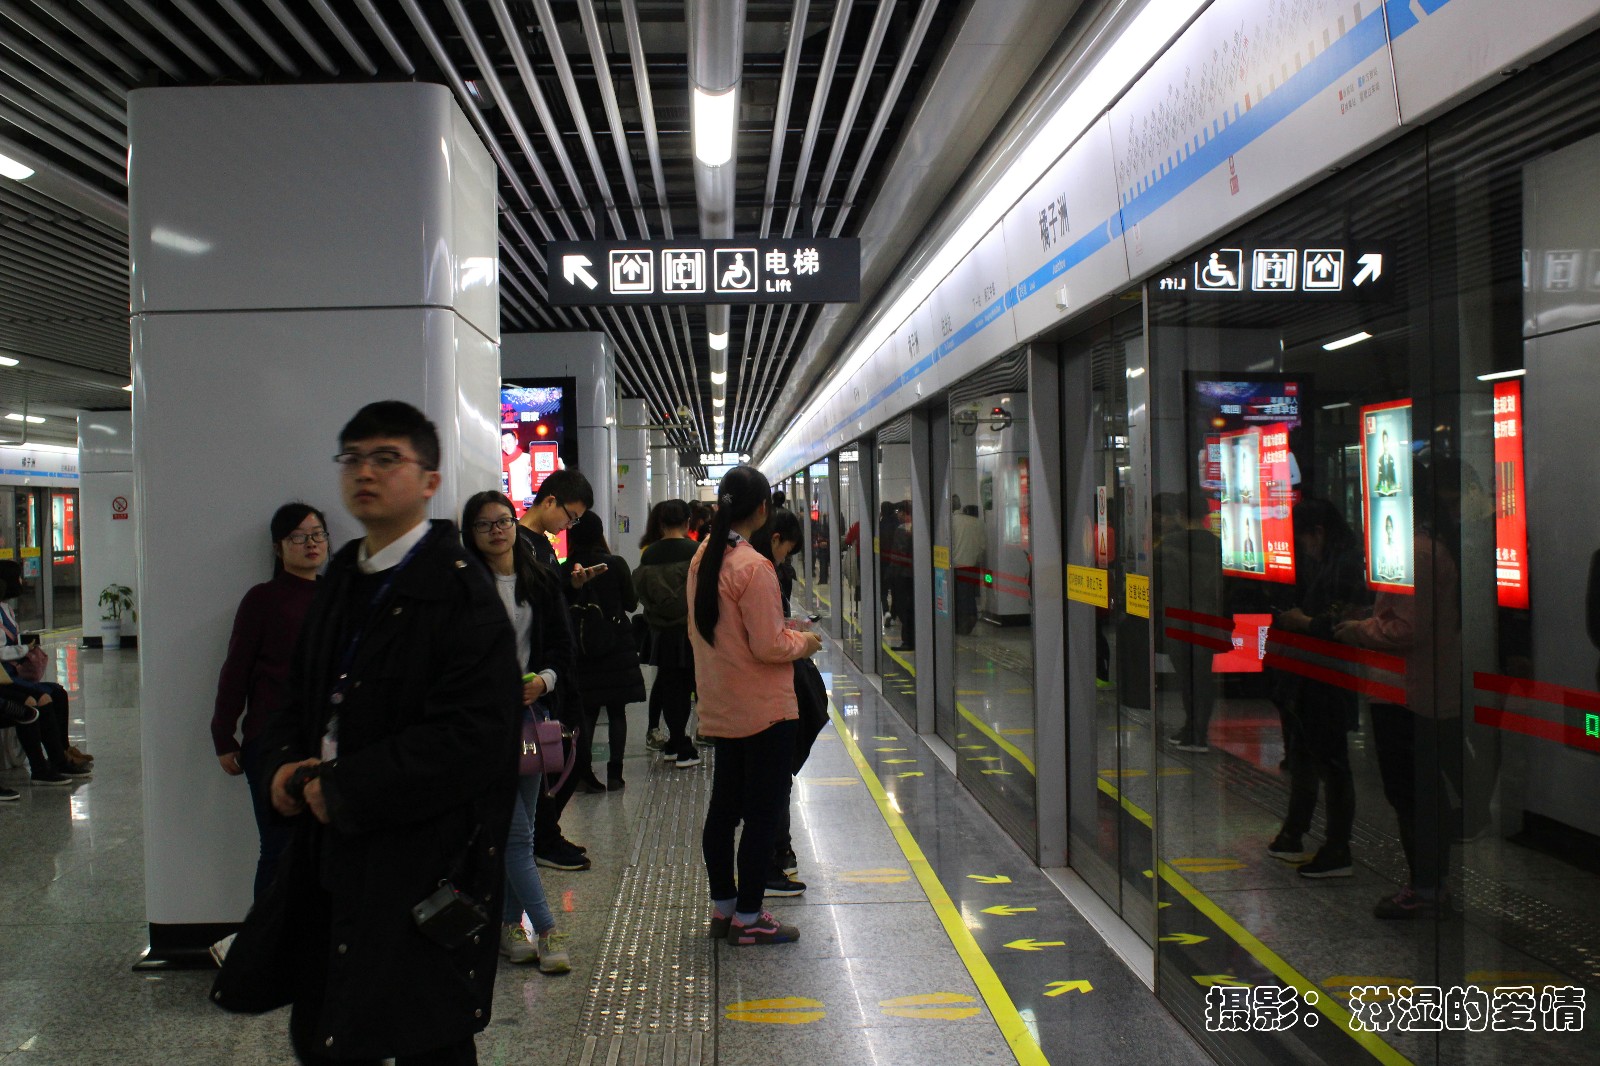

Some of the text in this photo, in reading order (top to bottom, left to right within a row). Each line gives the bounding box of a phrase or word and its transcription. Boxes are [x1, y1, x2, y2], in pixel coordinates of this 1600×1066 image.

[1037, 192, 1070, 252] 橘子洲
[765, 247, 820, 275] 电梯
[765, 279, 792, 292] Lift
